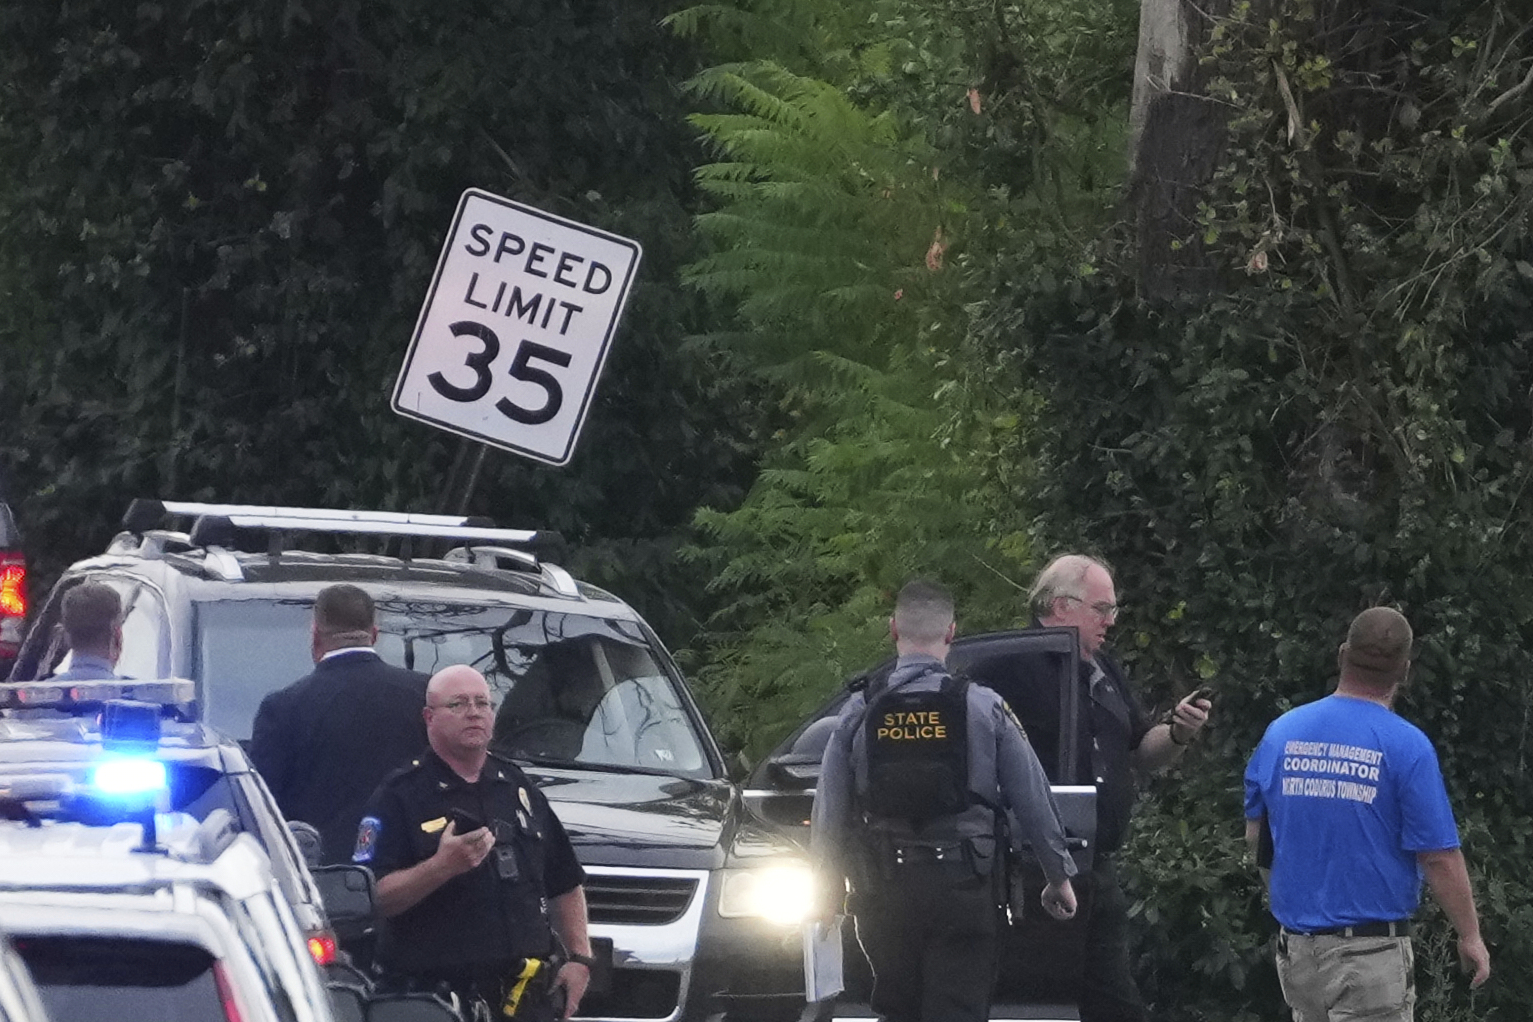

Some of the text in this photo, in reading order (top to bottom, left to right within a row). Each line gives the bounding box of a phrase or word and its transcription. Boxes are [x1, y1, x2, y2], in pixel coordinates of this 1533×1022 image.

[464, 223, 613, 295] SPEED
[463, 272, 584, 336] LIMIT
[427, 320, 572, 425] 35
[884, 711, 940, 726] STATE
[877, 725, 946, 740] POLICE
[1328, 743, 1383, 765] MANAGEMENT
[1283, 757, 1380, 782] COORDINATOR
[1337, 780, 1377, 804] TOWNSHIP
